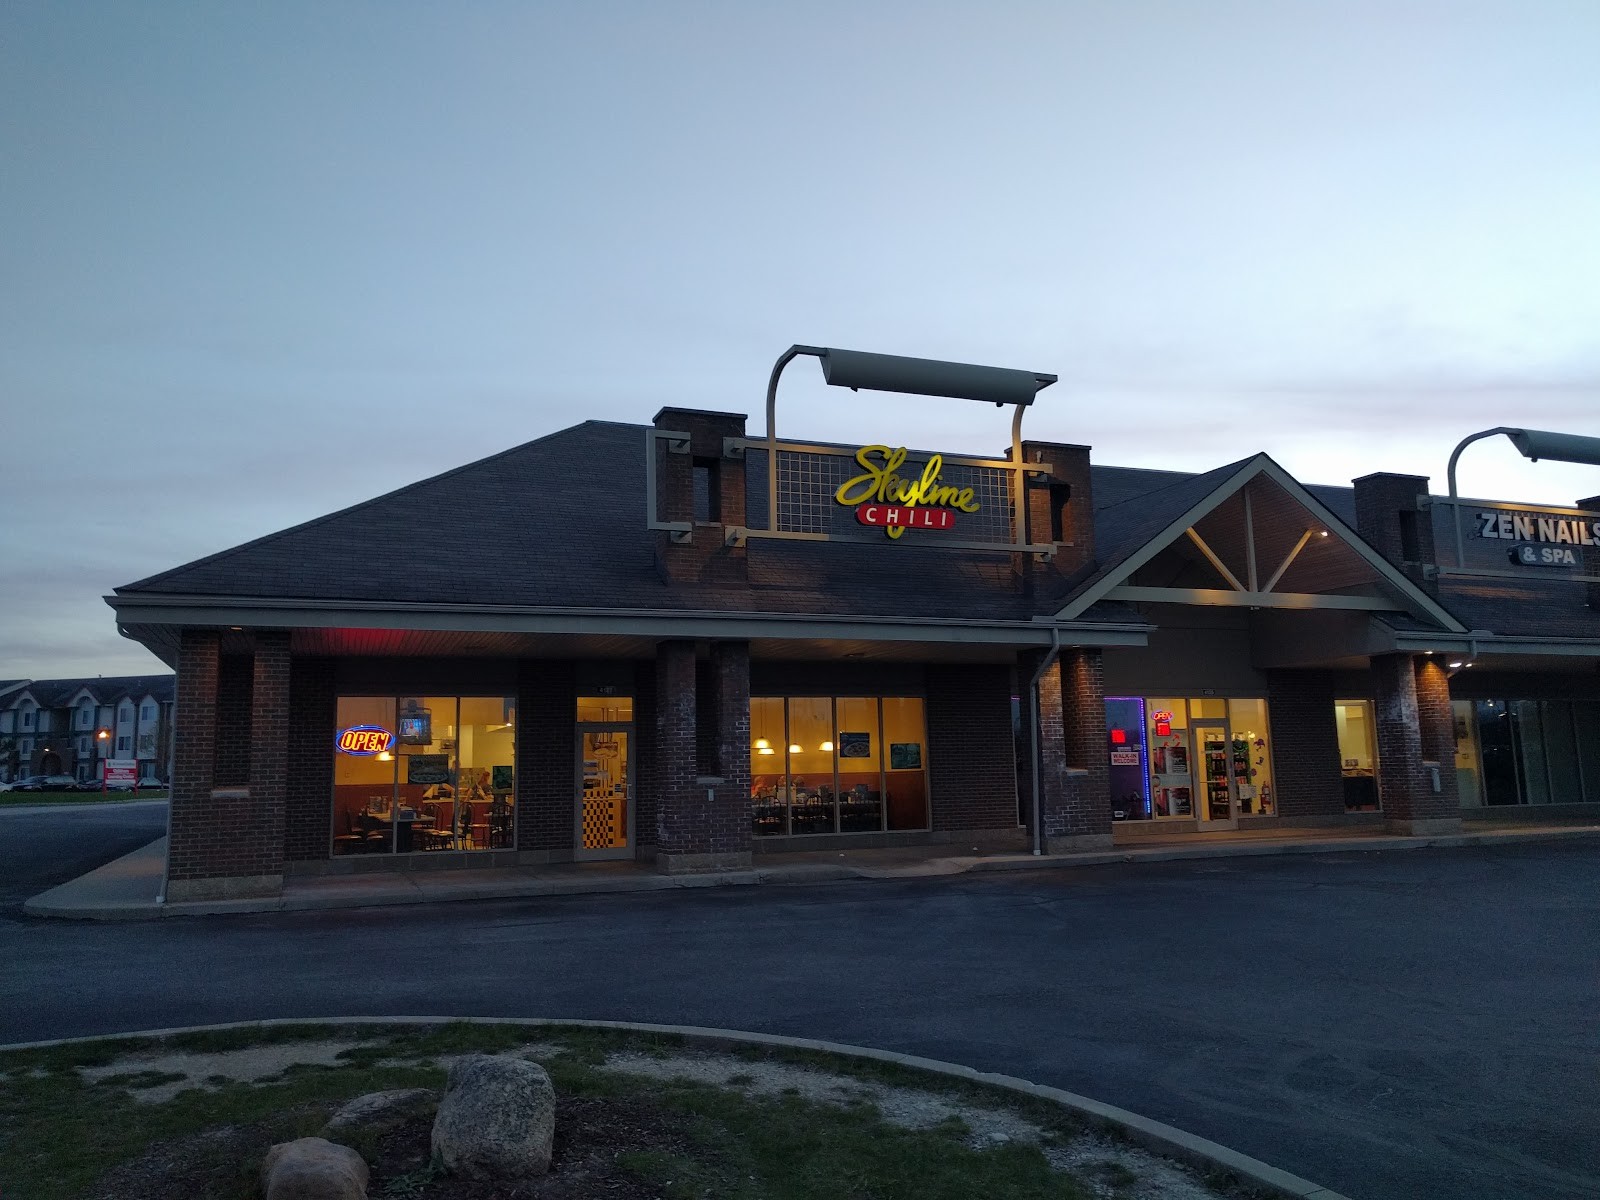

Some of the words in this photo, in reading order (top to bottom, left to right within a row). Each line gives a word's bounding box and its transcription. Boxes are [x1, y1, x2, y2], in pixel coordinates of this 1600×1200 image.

[836, 445, 980, 539] Skyline
[866, 507, 947, 526] CHILI
[1482, 513, 1531, 541] ZEN
[1523, 547, 1537, 562] &
[1541, 548, 1576, 564] SPA
[341, 731, 390, 751] OPEN
